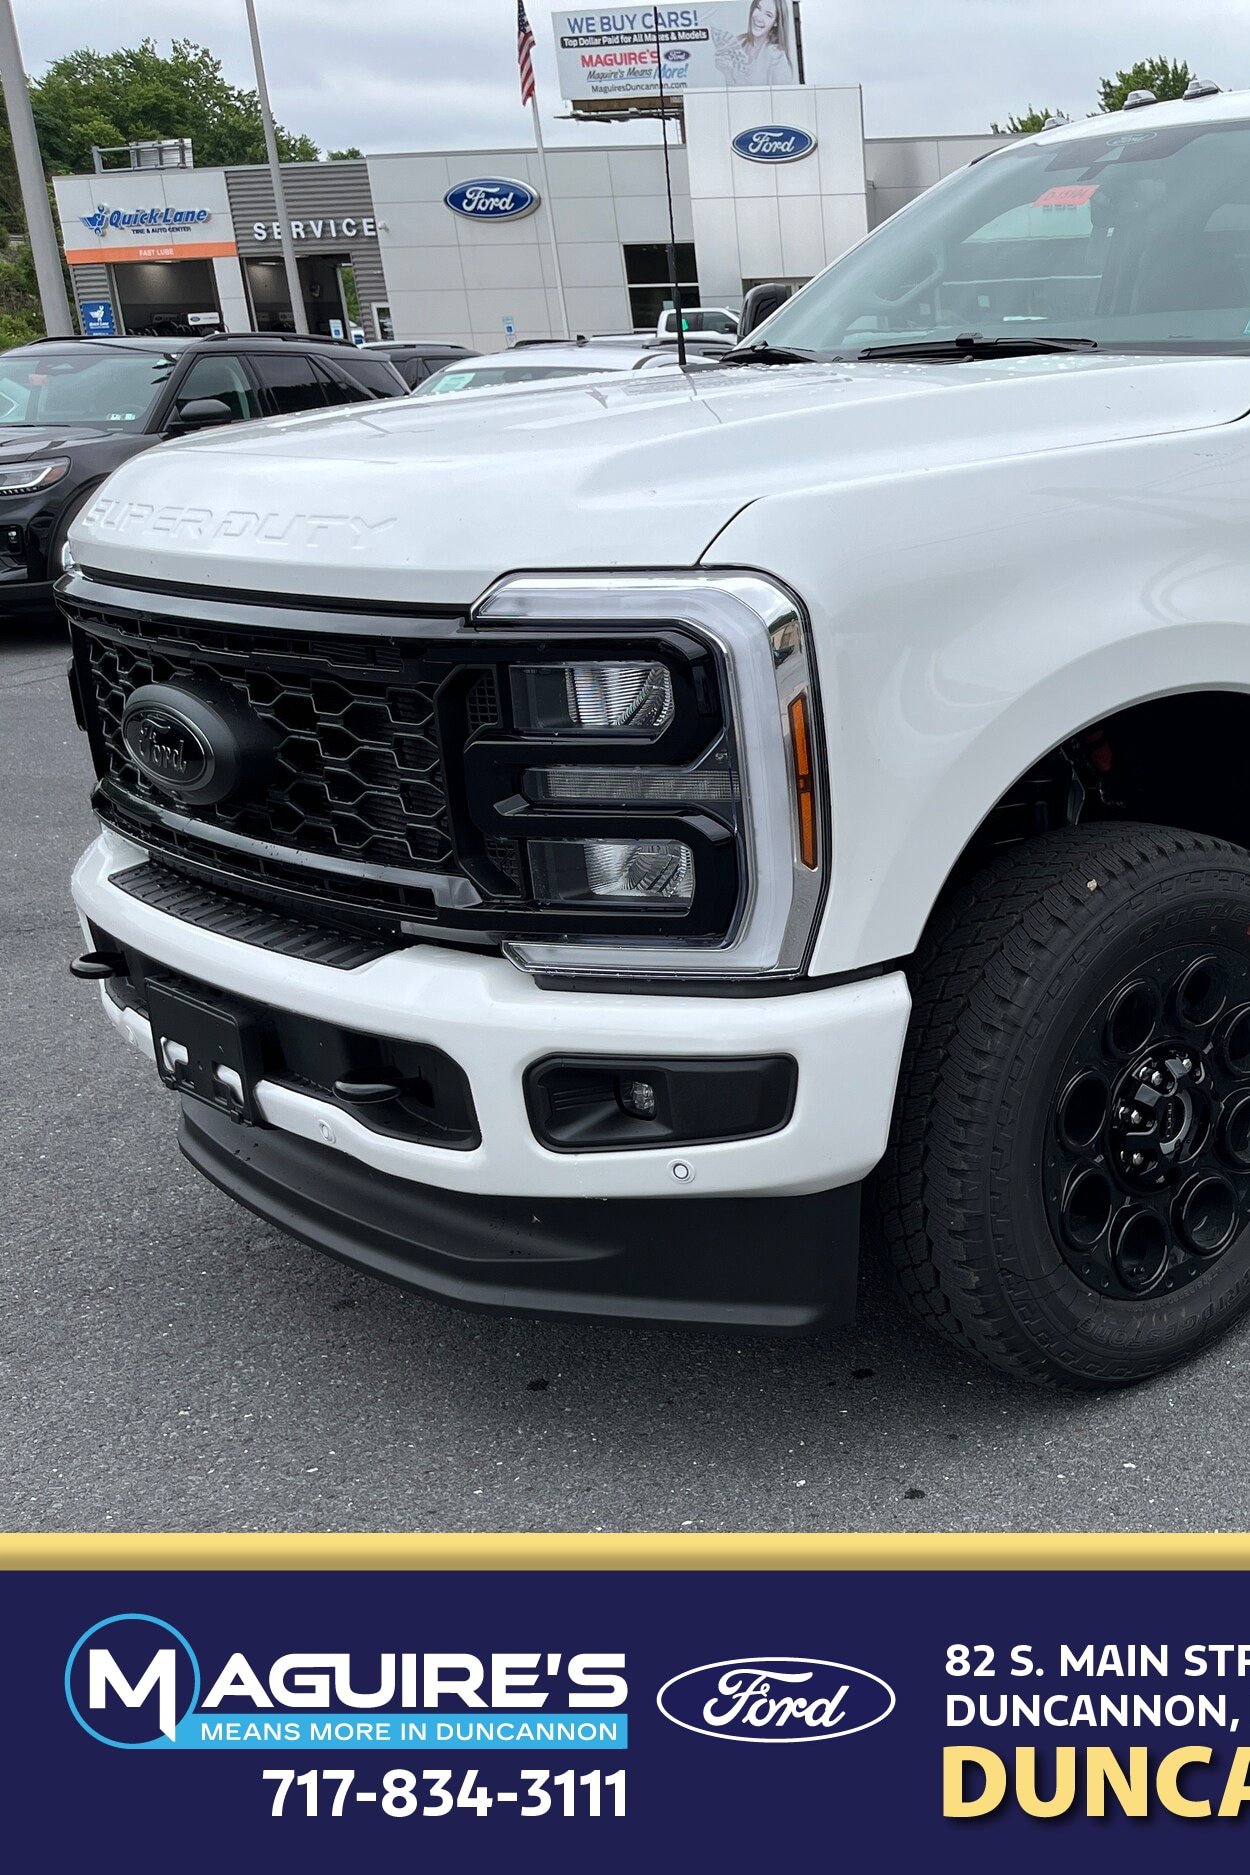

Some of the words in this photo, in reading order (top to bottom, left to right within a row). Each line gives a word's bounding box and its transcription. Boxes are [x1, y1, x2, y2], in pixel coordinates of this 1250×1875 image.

[567, 17, 596, 34] WE
[600, 14, 637, 32] BUY
[641, 10, 699, 29] CARS!
[563, 38, 578, 48] Top
[578, 37, 601, 46] Dollar
[602, 35, 620, 45] Paid
[620, 34, 632, 43] for
[633, 33, 644, 43] All
[645, 32, 670, 42] Maes
[670, 31, 677, 40] &
[678, 29, 707, 40] Models
[581, 49, 659, 68] MAGUIRE'S
[587, 68, 625, 82] Maguire's
[627, 67, 652, 77] Means
[653, 62, 689, 79] More!
[591, 82, 688, 94] MaguiresDuncannn.com
[748, 132, 795, 153] Ford
[462, 186, 515, 212] Ford
[109, 209, 159, 229] Quick
[163, 207, 208, 224] Lane
[253, 217, 376, 241] SERVICE
[156, 248, 174, 256] LUBE
[82, 498, 213, 537] SUPER
[213, 510, 398, 550] DUTY
